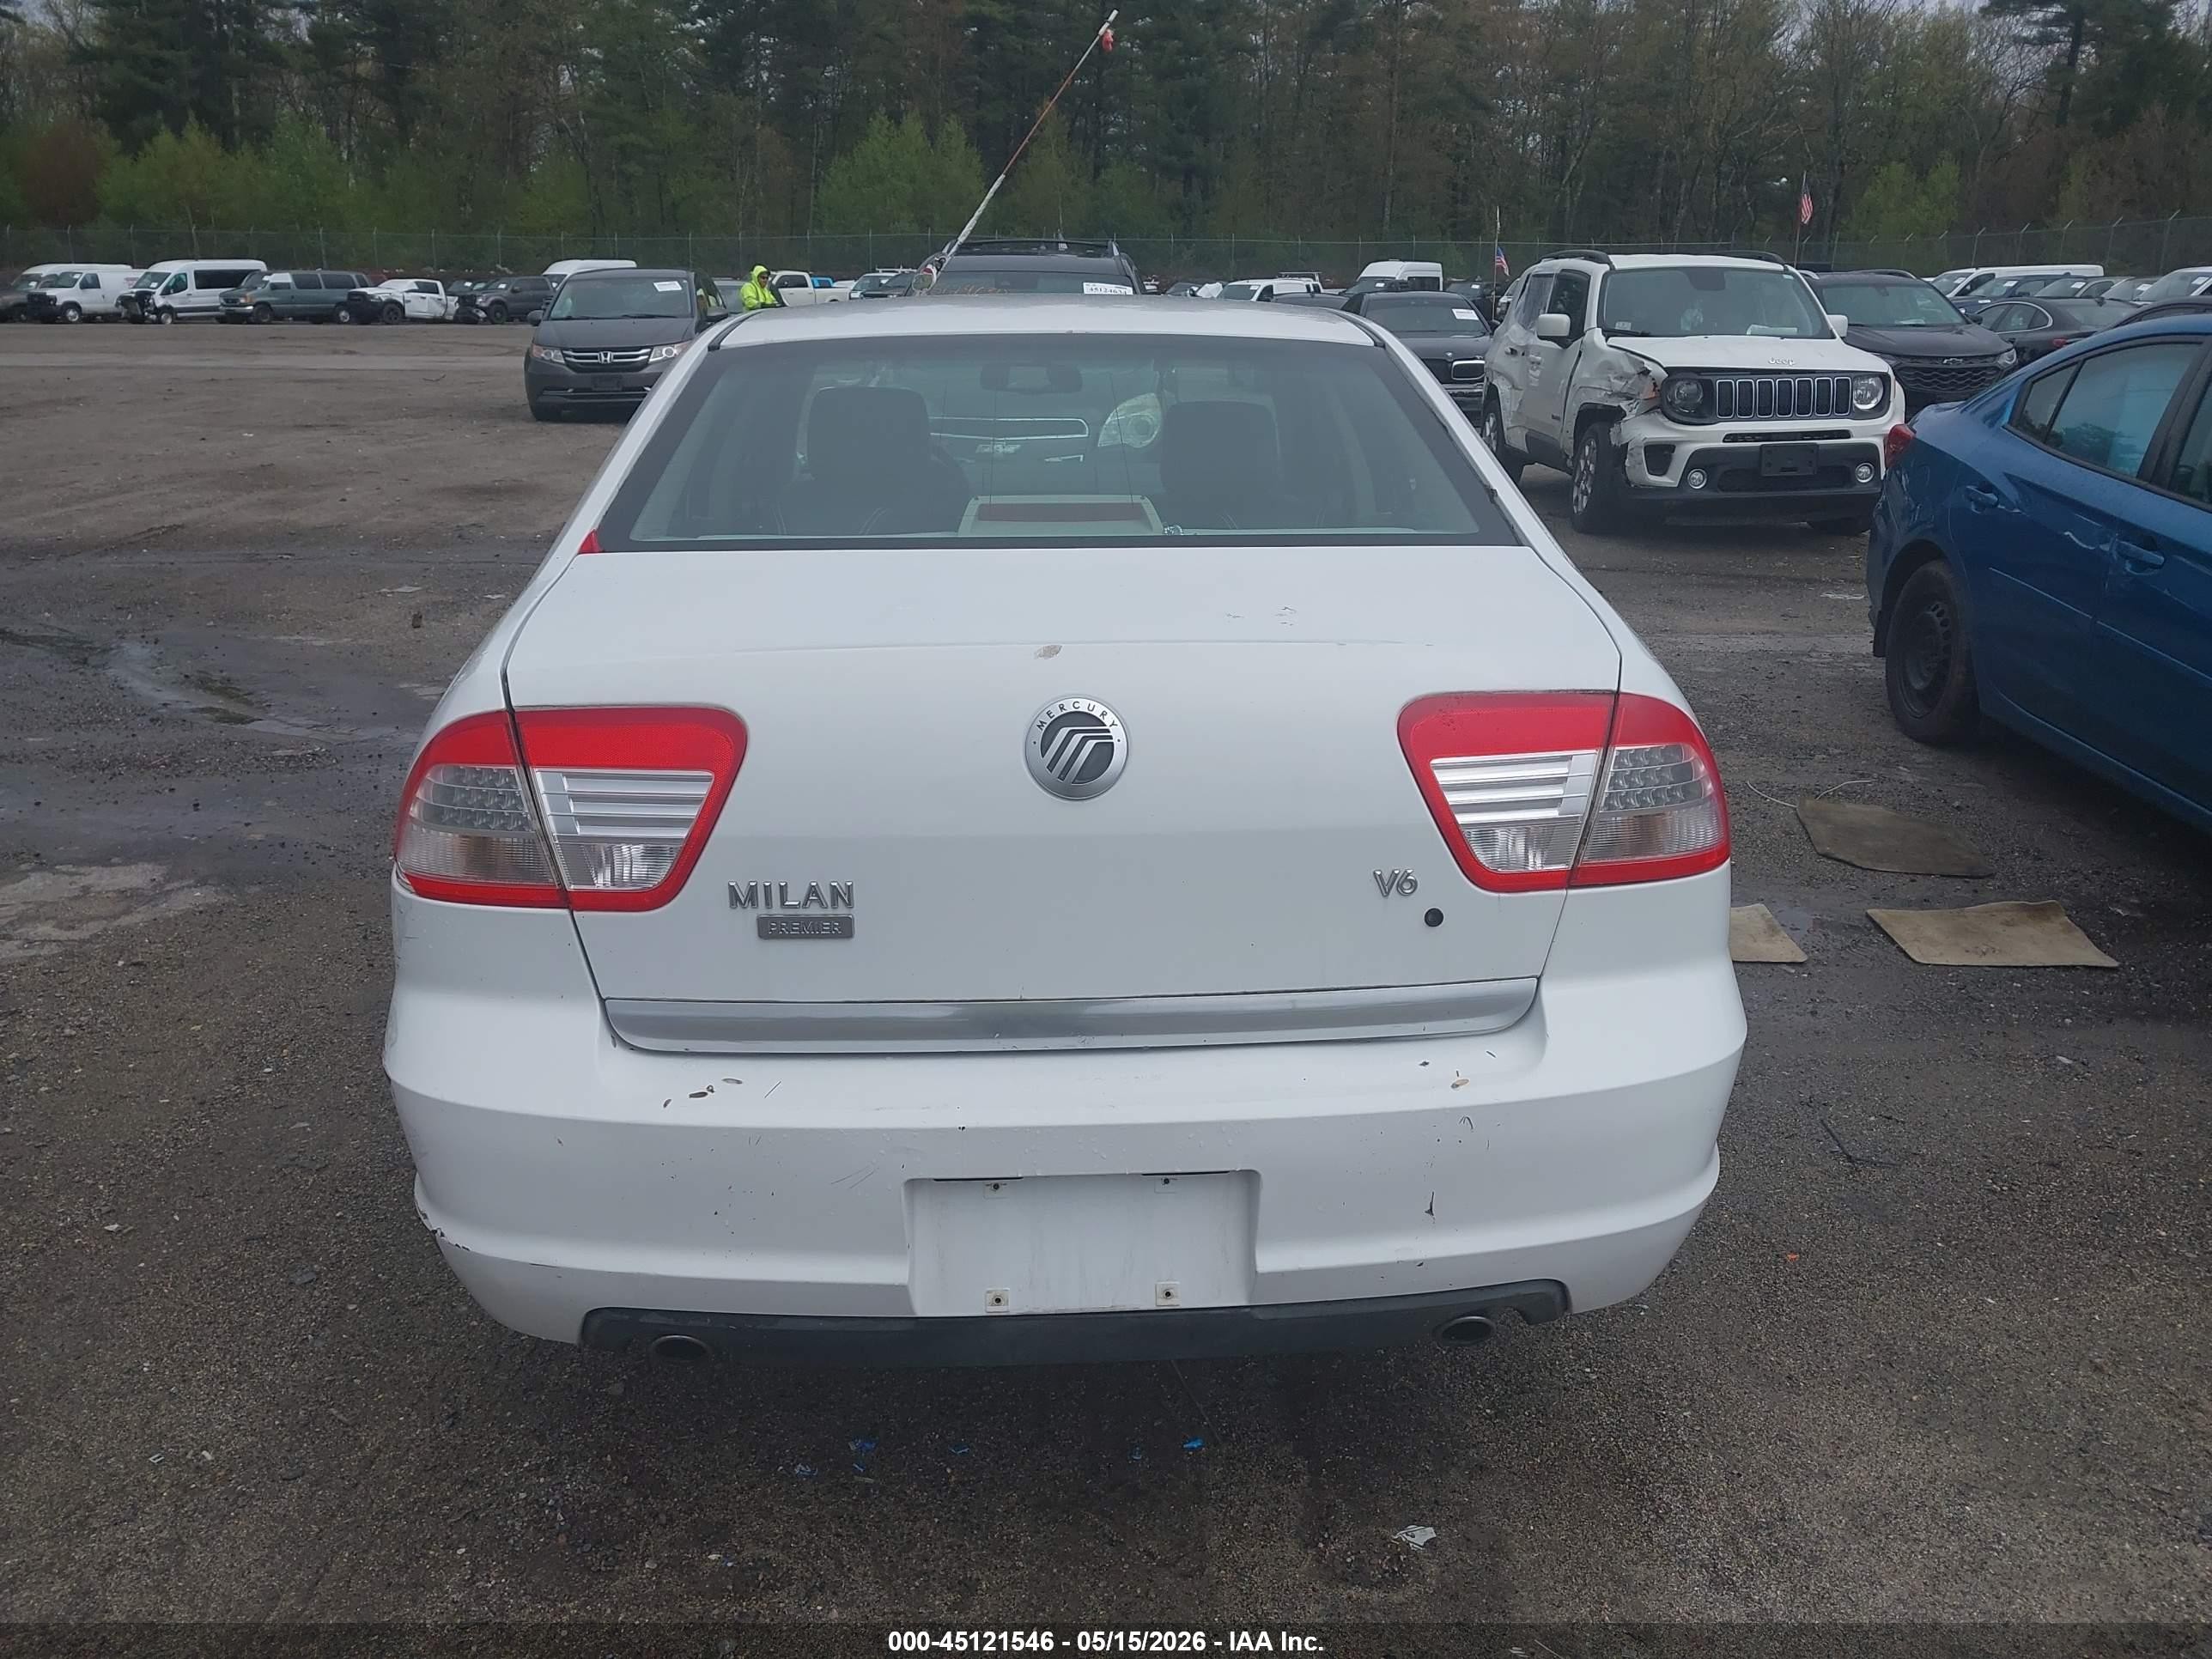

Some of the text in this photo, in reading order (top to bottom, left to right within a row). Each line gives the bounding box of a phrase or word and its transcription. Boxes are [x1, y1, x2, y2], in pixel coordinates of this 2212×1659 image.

[1768, 357, 1796, 367] Jeep
[1036, 701, 1118, 732] MERCURY
[728, 881, 854, 909] MILAN
[1373, 868, 1418, 896] V6
[769, 921, 842, 934] PREMIER
